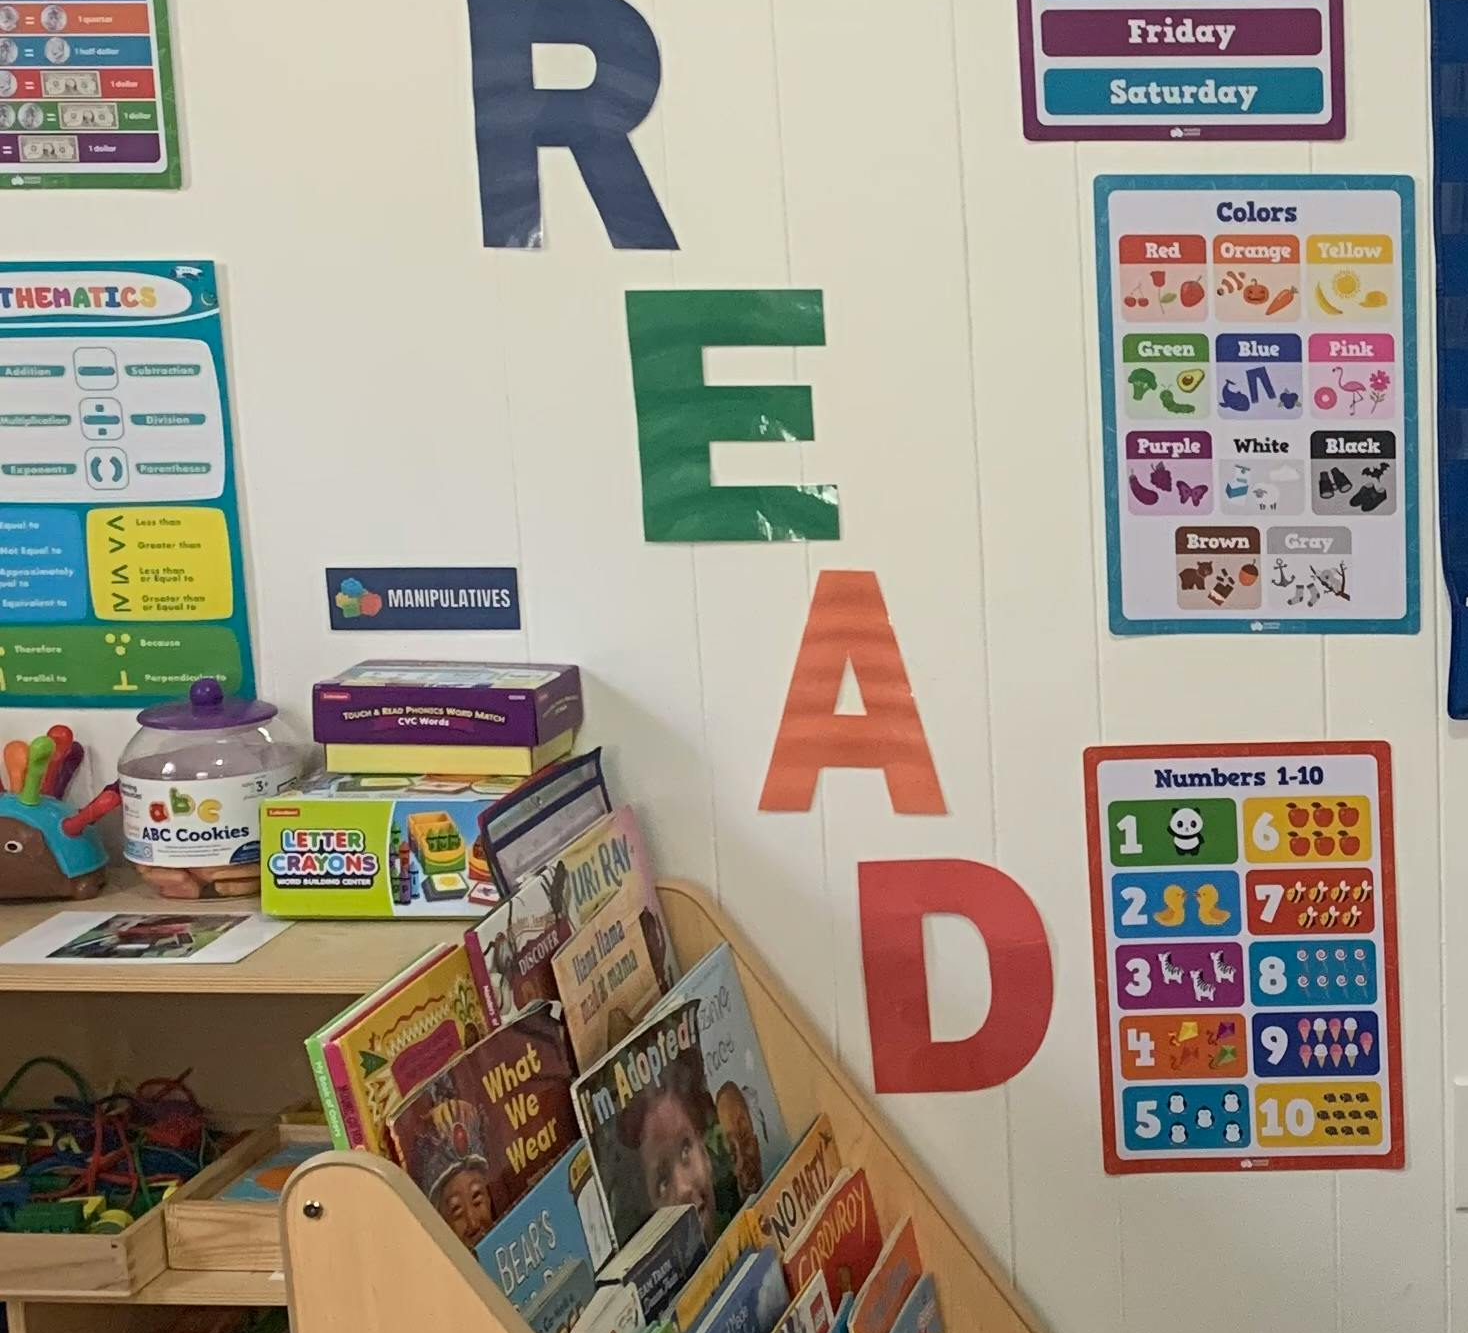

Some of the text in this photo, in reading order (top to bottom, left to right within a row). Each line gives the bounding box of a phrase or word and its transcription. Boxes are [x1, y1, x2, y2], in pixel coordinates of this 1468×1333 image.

[1127, 18, 1236, 50] Friday
[1109, 79, 1258, 111] Saturday
[1217, 202, 1297, 223] Colors
[1144, 243, 1181, 258] Red
[1237, 341, 1280, 357] Blue
[1234, 438, 1289, 454] White
[388, 588, 511, 609] MANIPULATIVES
[398, 718, 449, 727] CVC Words
[1155, 766, 1324, 788] Numbers 1-10
[142, 826, 249, 842] ABC Cookies
[283, 830, 363, 850] LETTER
[268, 852, 379, 877] CRAYONS
[342, 878, 371, 886] CENTER
[518, 932, 560, 977] DISCOVER
[482, 1042, 542, 1104] What
[580, 1007, 699, 1134] I'm Adopted!
[504, 1090, 540, 1130] We
[1259, 1099, 1315, 1136] 10
[506, 1117, 558, 1174] Wear
[771, 1191, 796, 1251] NO
[798, 1181, 866, 1287] CORDUROY
[494, 1210, 556, 1298] BEAR'S
